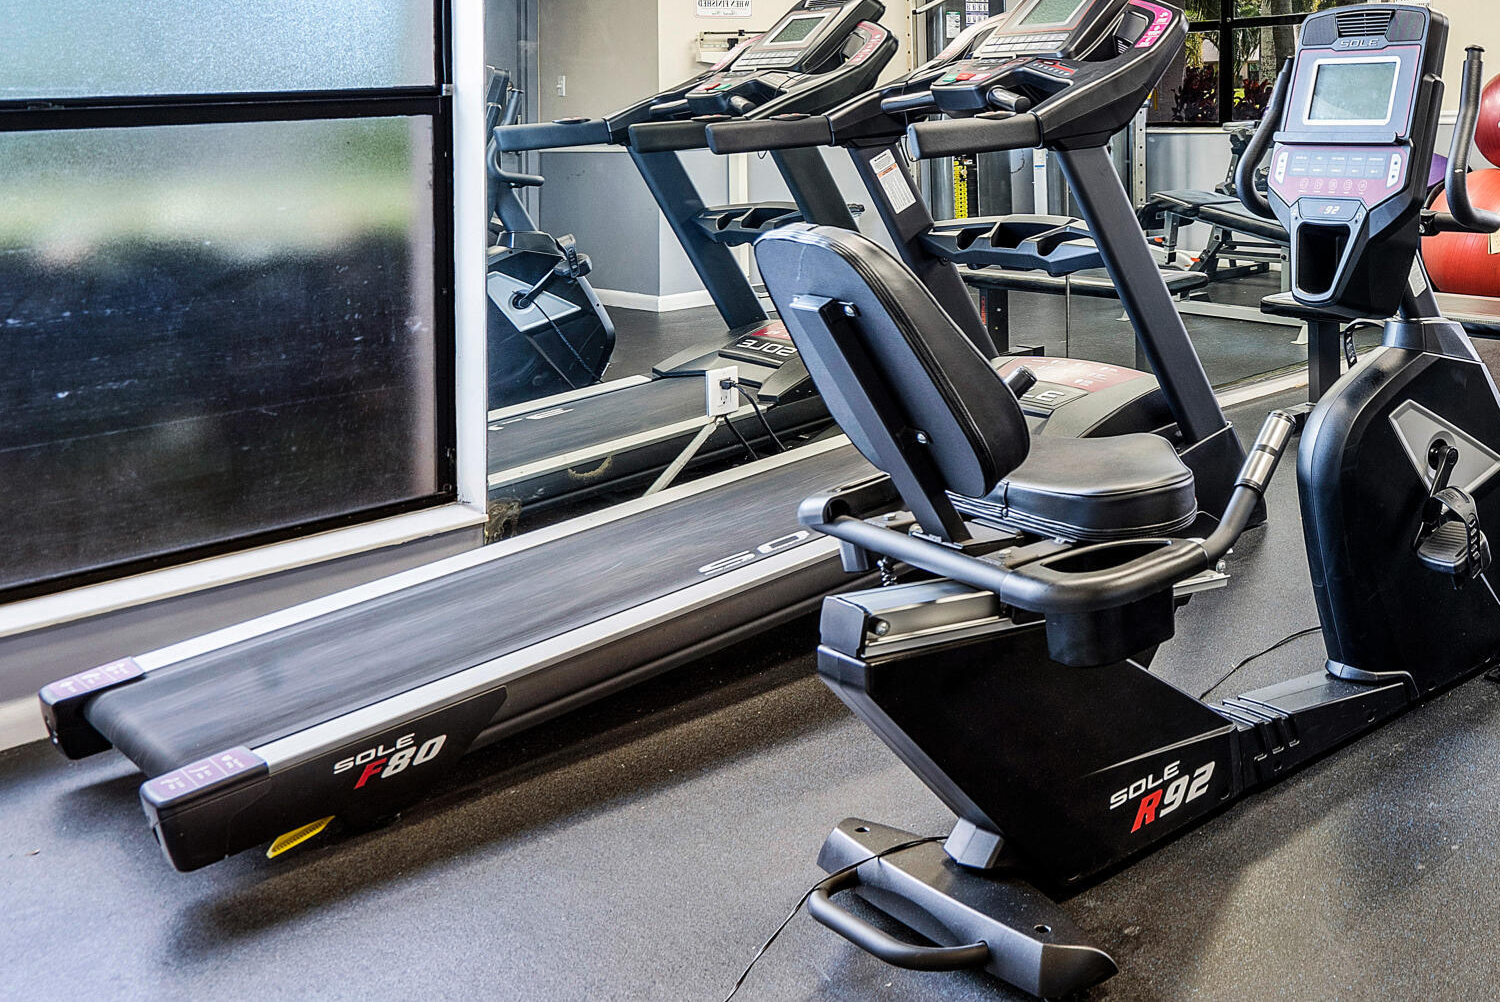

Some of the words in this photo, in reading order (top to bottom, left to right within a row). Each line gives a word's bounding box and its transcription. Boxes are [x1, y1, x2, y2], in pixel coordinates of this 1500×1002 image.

[1340, 38, 1379, 48] SOLE
[698, 530, 811, 576] SO
[333, 732, 416, 775] SOLE
[353, 734, 447, 790] F80
[1109, 760, 1181, 811] SOLE
[1130, 760, 1216, 834] R92
